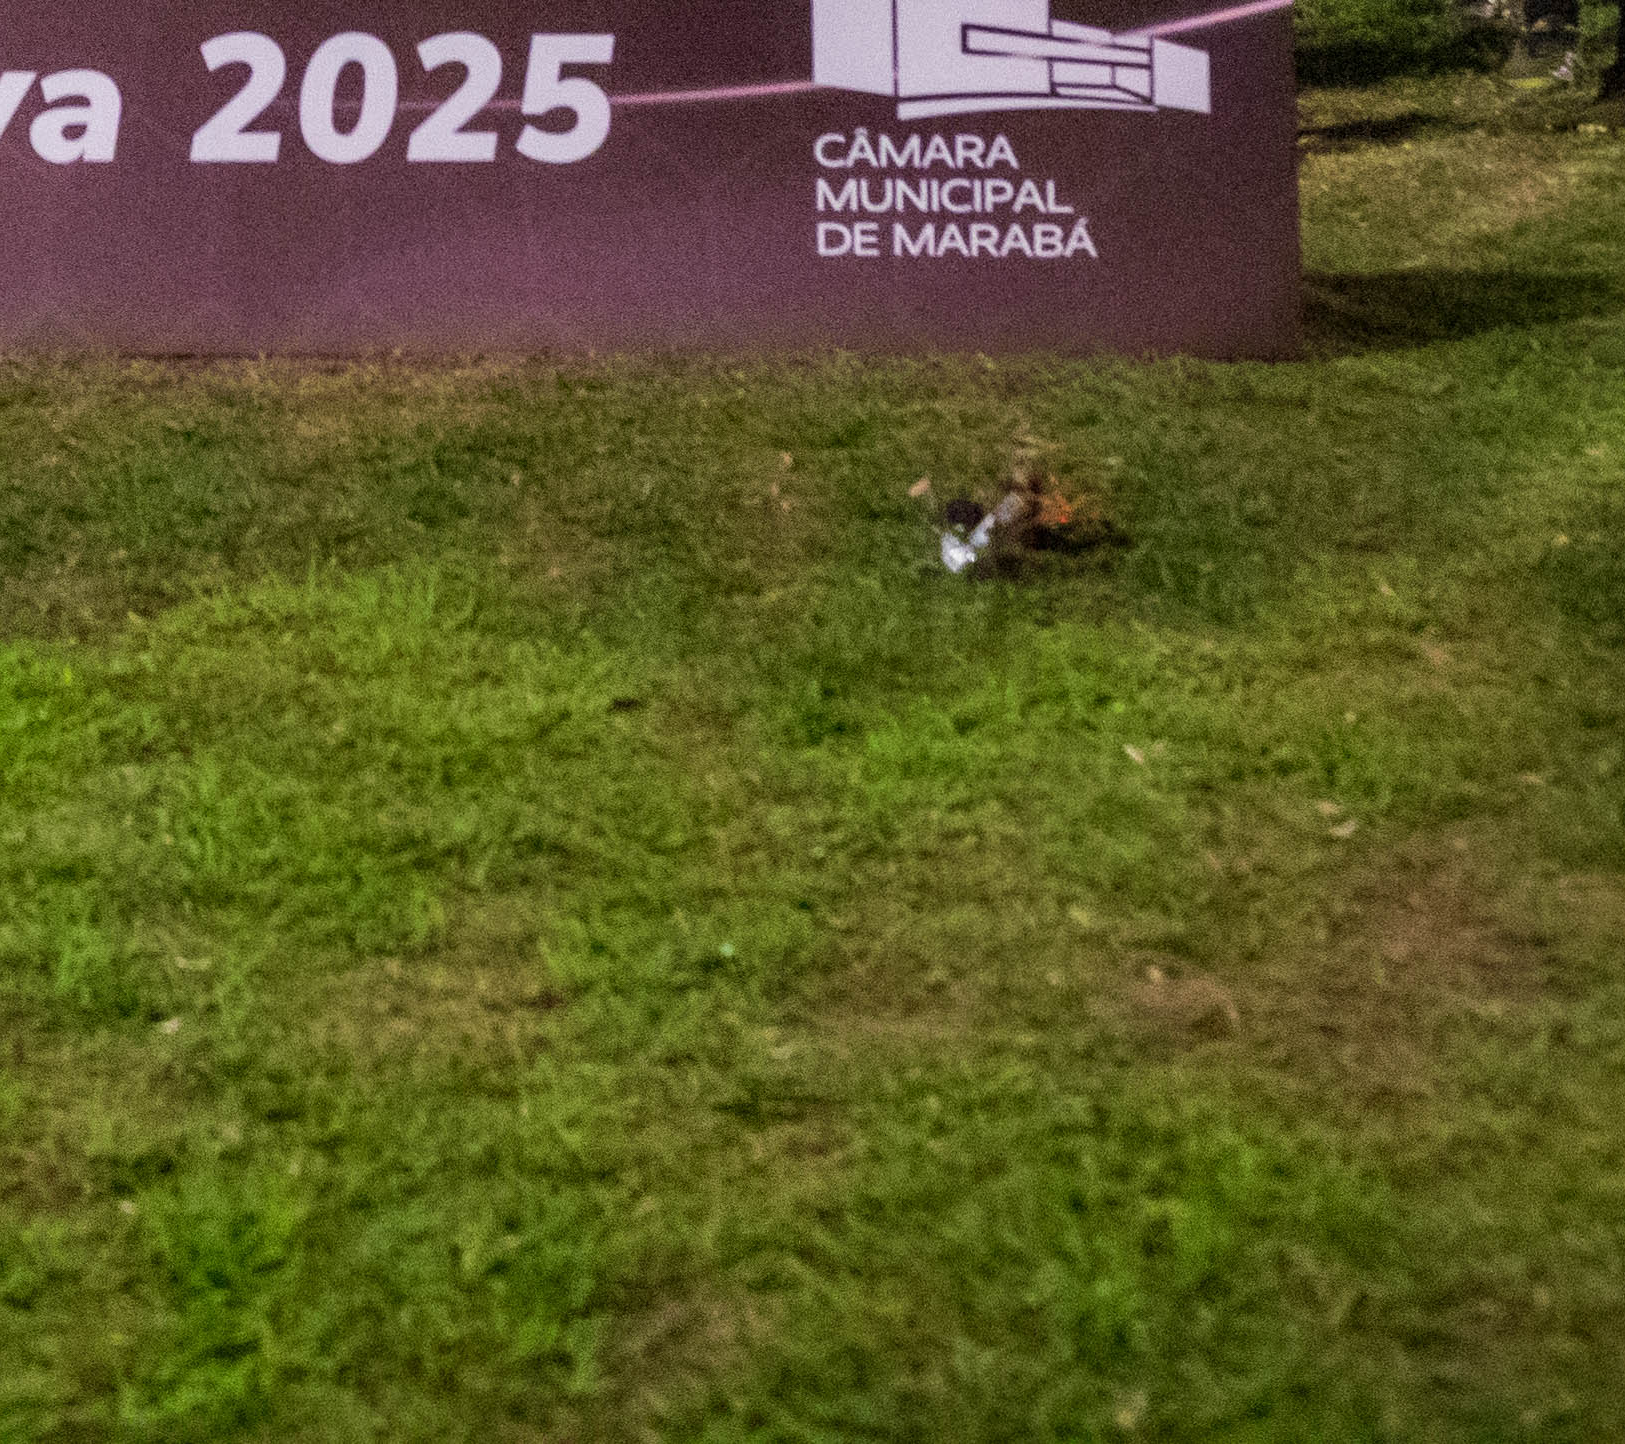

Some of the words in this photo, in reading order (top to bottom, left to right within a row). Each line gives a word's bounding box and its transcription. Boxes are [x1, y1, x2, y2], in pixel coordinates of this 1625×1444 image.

[189, 30, 616, 165] 2025
[813, 126, 1020, 170] CÂMARA
[814, 178, 1075, 214] MUNICIPAL
[816, 222, 881, 257] DE
[893, 216, 1098, 258] MARABÁ
